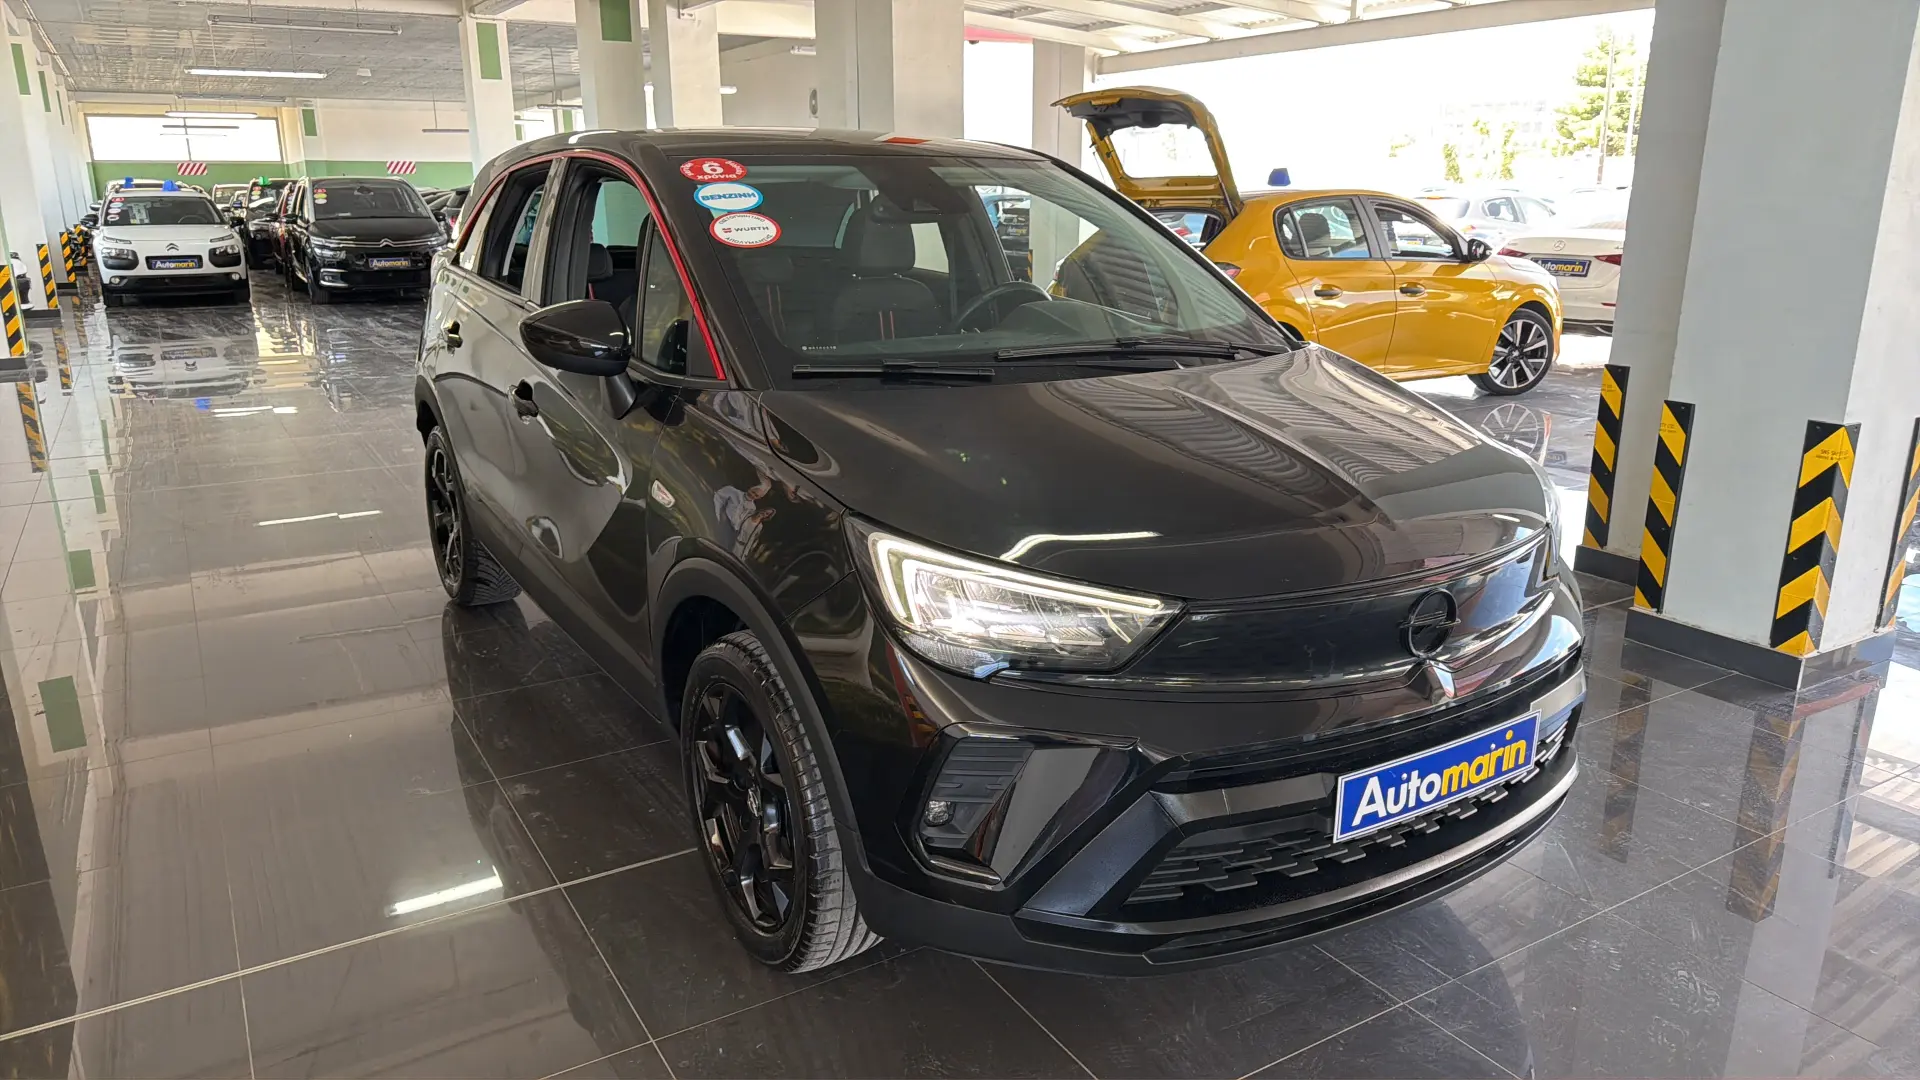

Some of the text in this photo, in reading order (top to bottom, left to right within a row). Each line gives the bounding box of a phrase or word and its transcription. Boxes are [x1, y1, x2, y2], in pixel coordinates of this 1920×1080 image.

[702, 162, 724, 175] 6
[155, 259, 196, 269] Automarin
[372, 258, 409, 268] Automarin
[1351, 729, 1527, 827] Automarin
